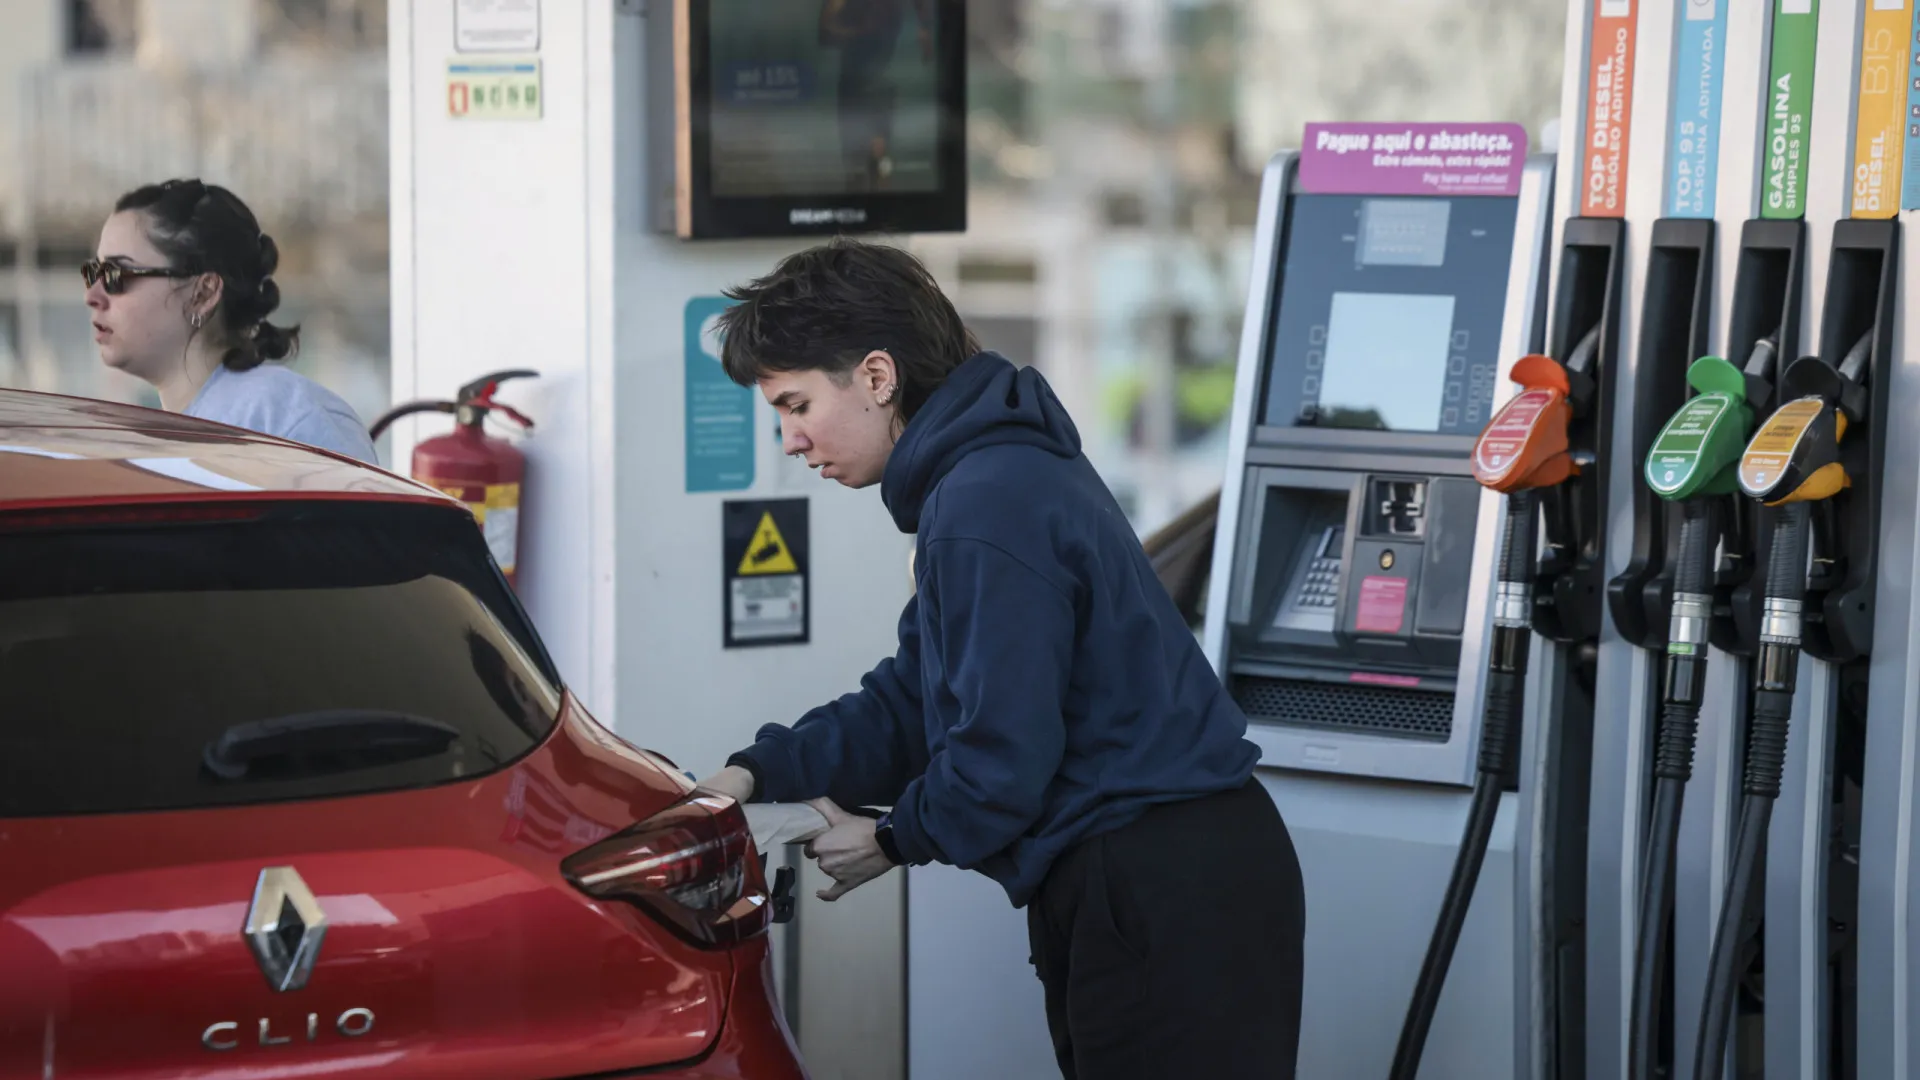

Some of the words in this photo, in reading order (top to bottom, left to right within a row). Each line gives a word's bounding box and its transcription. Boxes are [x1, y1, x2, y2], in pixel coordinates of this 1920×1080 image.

[1611, 27, 1628, 122] ADITIVADO
[1699, 26, 1714, 119] ADITIVADA
[1863, 27, 1892, 95] B15
[1593, 57, 1613, 148] DIESEL
[1790, 114, 1802, 134] 95
[1316, 131, 1370, 154] Pague
[1372, 130, 1412, 154] aqui
[1414, 134, 1426, 151] e
[1428, 130, 1513, 153] abasteça.
[1680, 121, 1695, 154] 95
[1694, 125, 1708, 212] GASOLINA
[1769, 73, 1792, 209] GASOLINA
[1867, 131, 1885, 211] DIESEL
[1589, 155, 1605, 209] TOP
[1675, 160, 1692, 211] TOP
[1786, 140, 1800, 209] SIMPLES
[1854, 163, 1869, 211] ECO
[201, 1007, 375, 1050] CLIO
